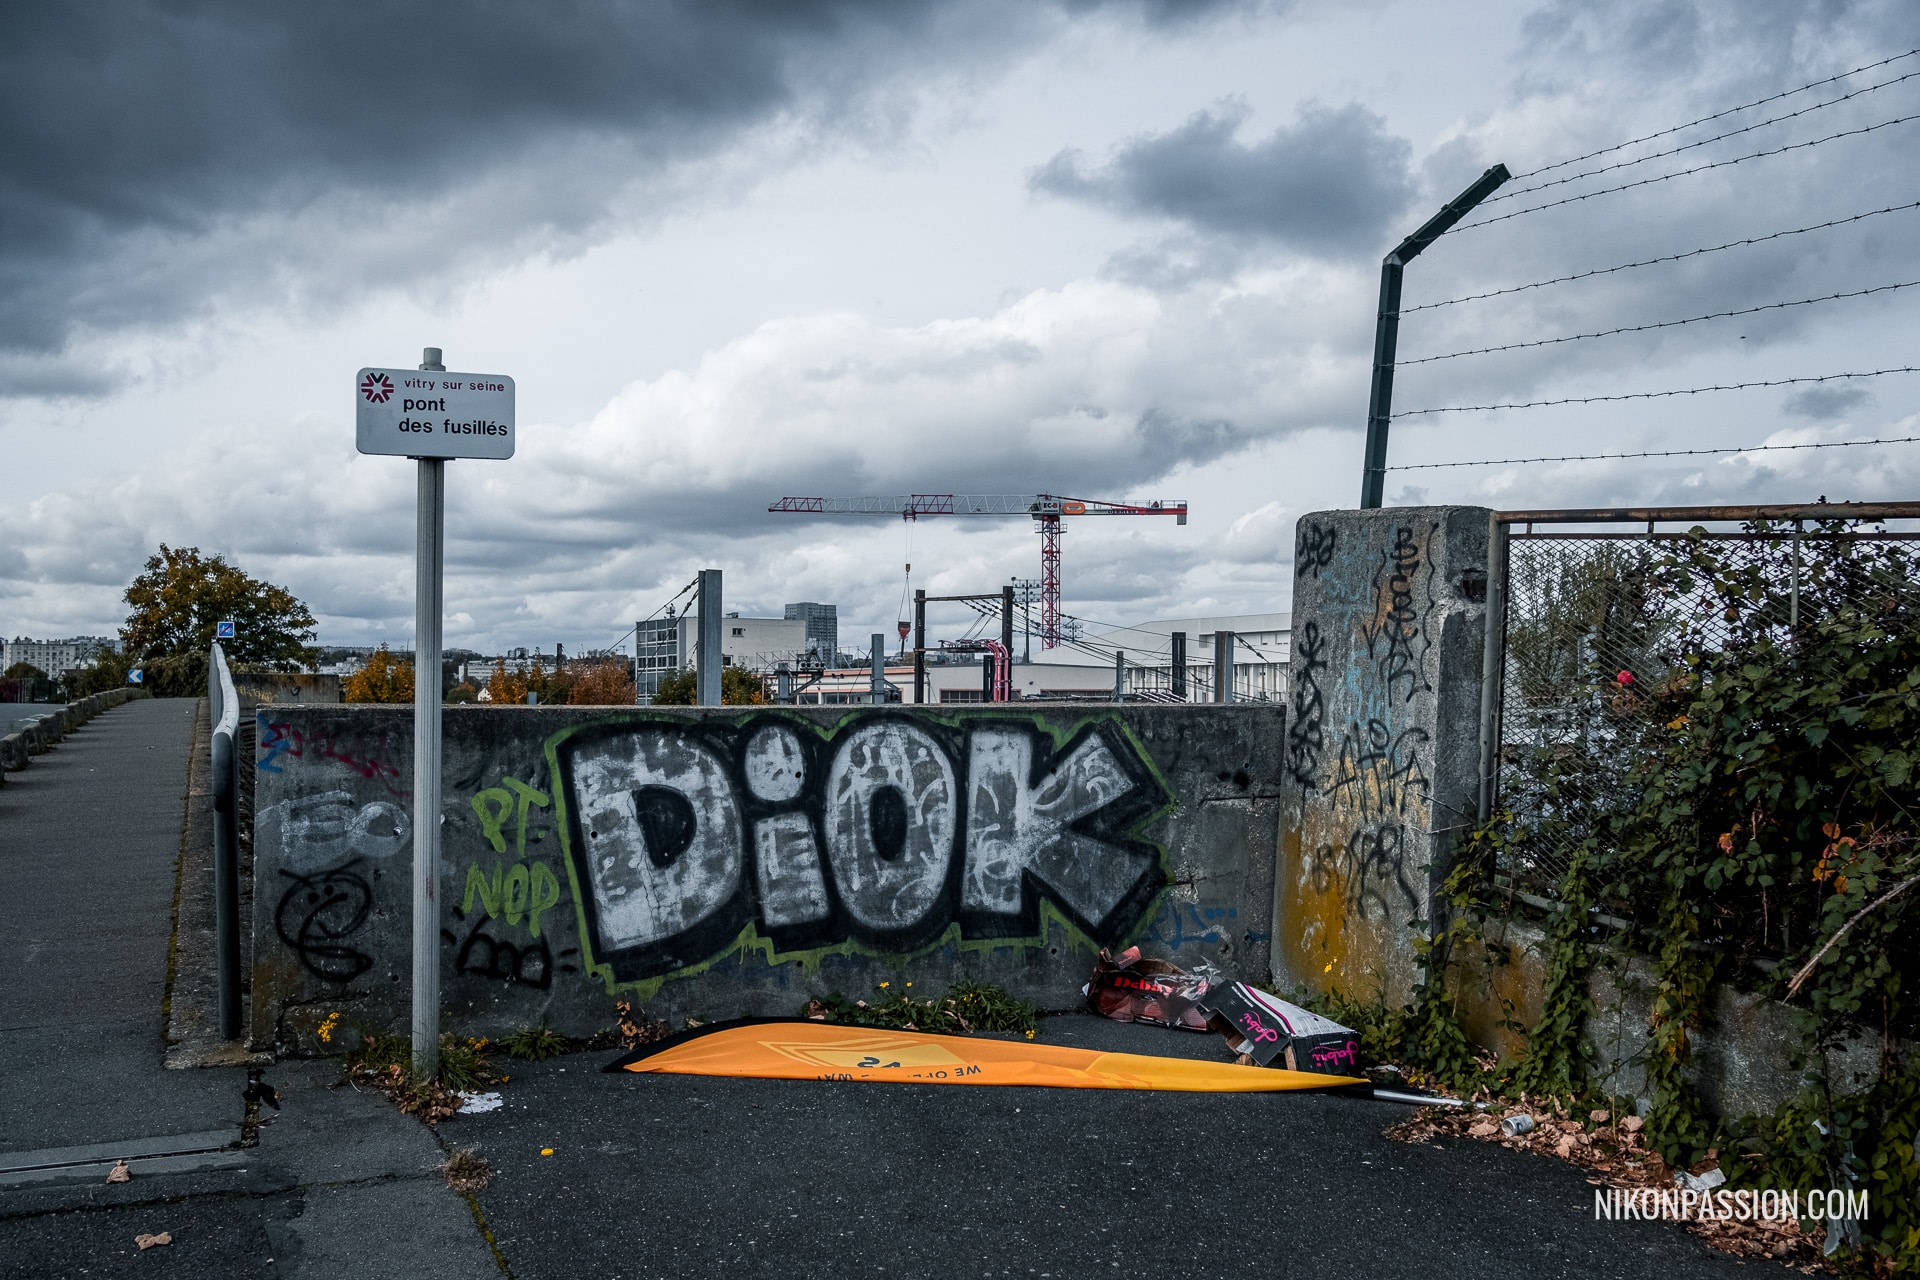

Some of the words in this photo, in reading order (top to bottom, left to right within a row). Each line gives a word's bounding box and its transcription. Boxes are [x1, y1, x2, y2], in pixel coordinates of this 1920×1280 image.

[404, 378, 436, 391] vitry
[442, 381, 463, 390] sur
[469, 381, 505, 392] seine
[403, 397, 446, 413] pont
[399, 418, 433, 433] des
[444, 419, 508, 436] fusillés
[954, 1064, 982, 1077] WE
